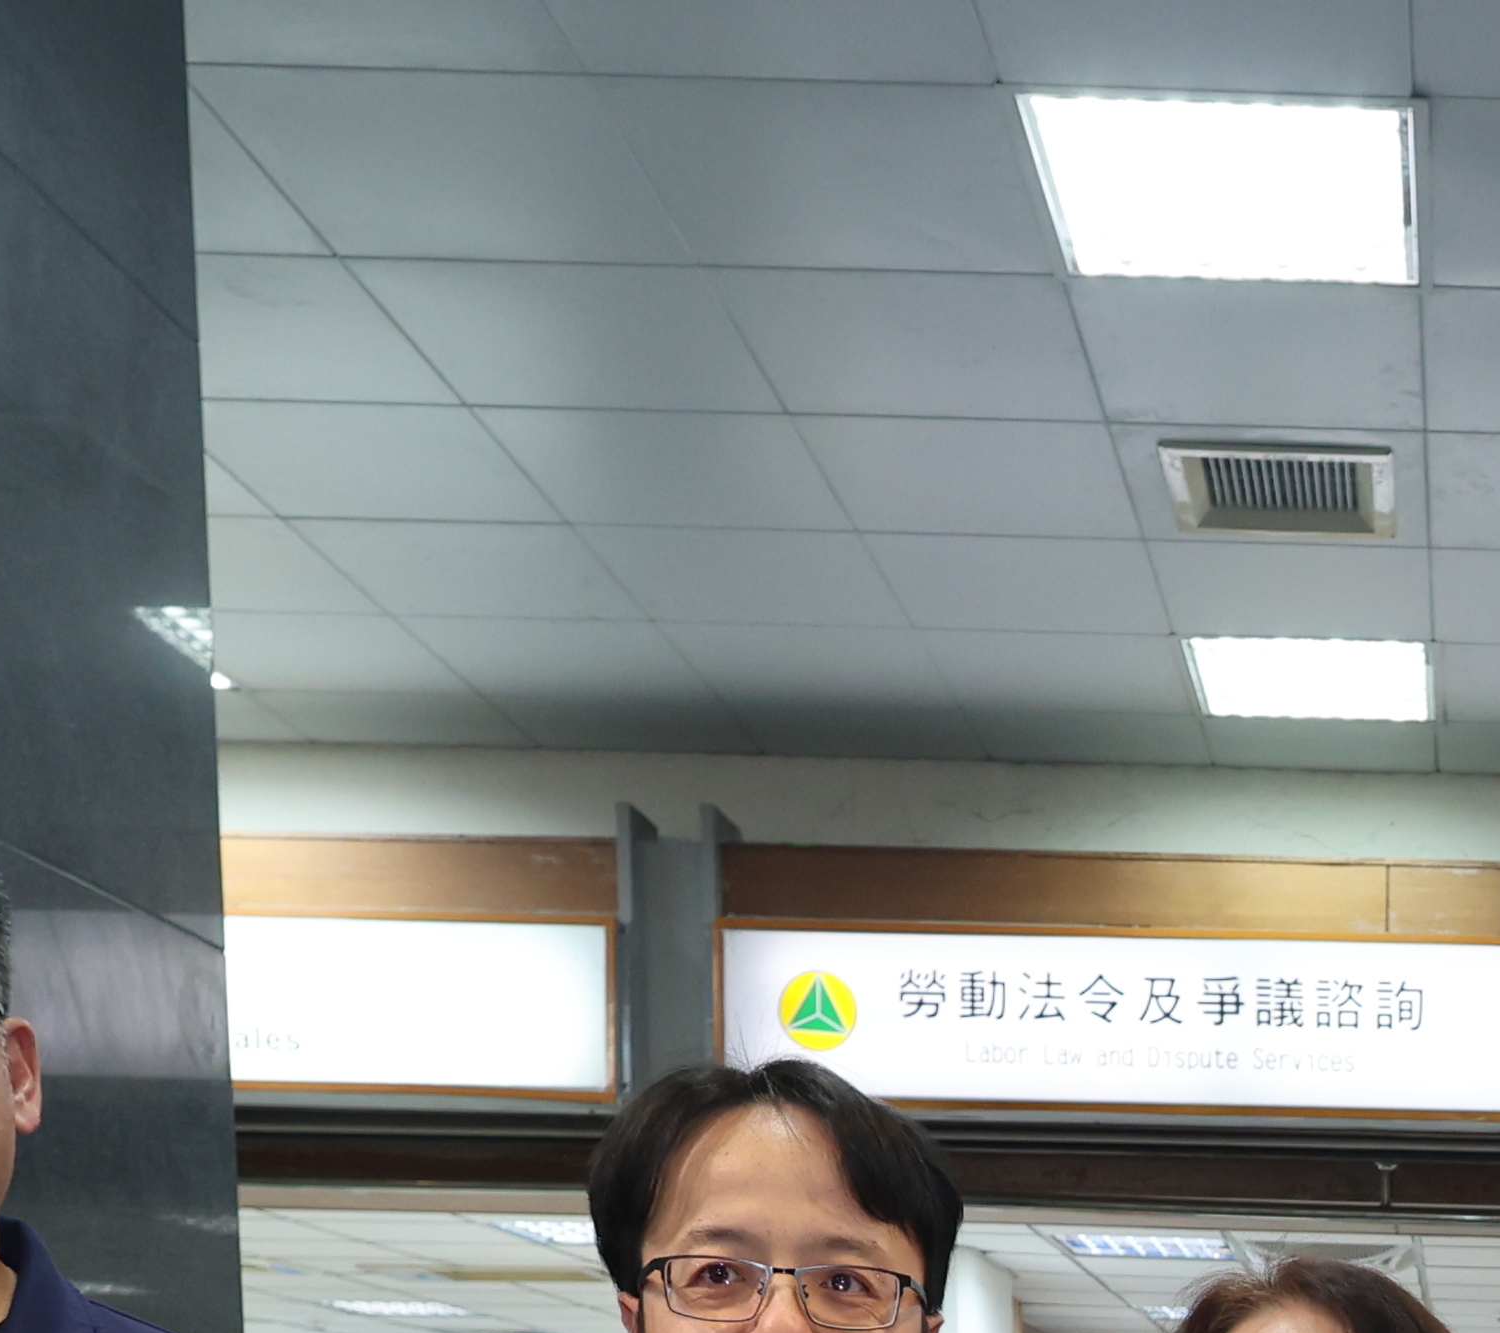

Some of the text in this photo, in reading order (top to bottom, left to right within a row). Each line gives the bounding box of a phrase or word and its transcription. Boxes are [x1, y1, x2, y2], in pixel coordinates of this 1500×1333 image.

[900, 968, 1425, 1032] 勞動法令及爭議諮詢
[965, 1042, 1355, 1073] Labor Law and Dispute Services
